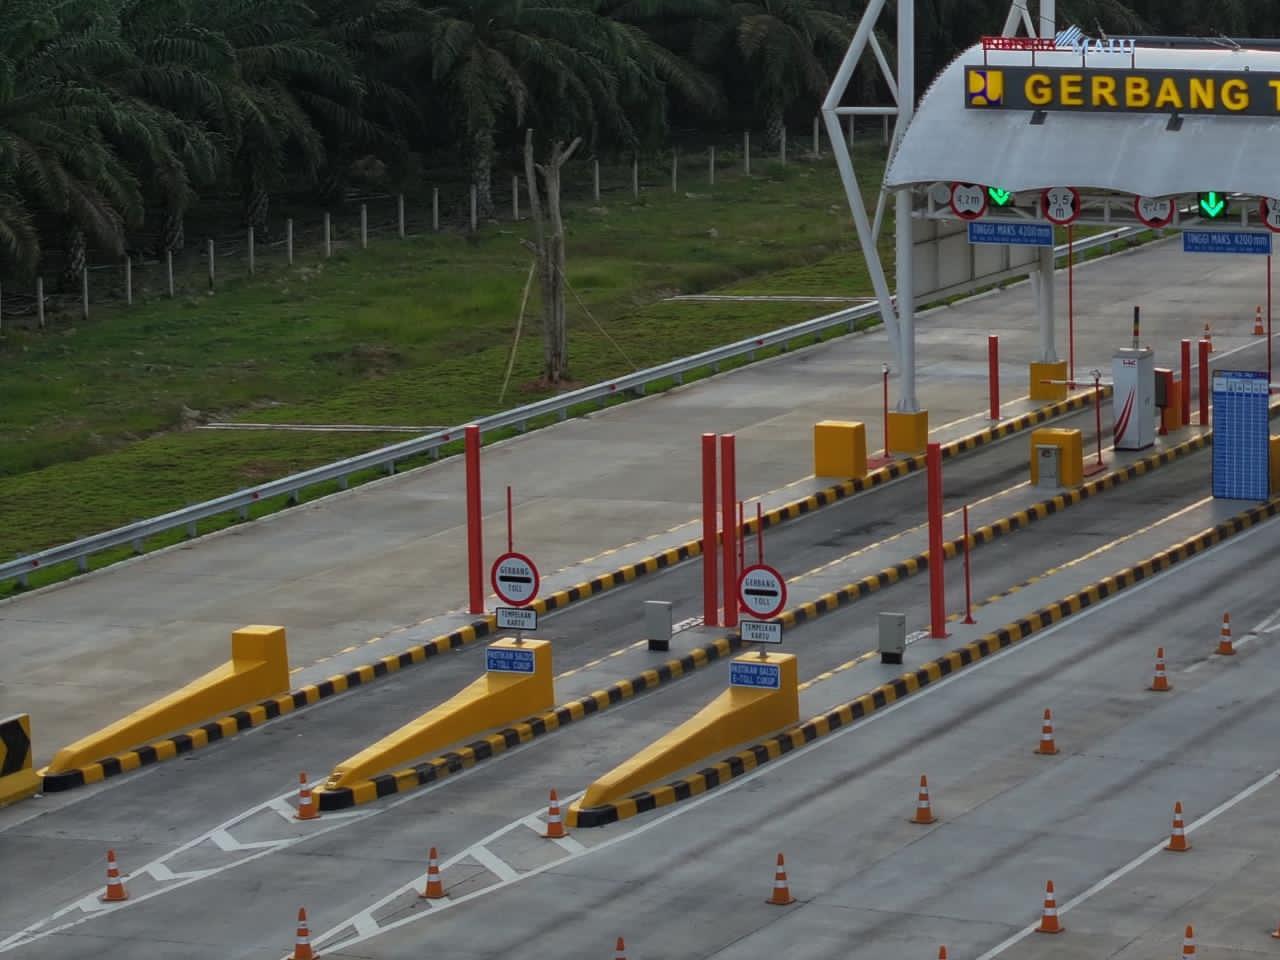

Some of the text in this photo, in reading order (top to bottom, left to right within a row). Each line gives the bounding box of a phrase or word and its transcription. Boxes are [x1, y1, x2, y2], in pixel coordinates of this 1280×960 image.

[1024, 74, 1250, 111] GERBANG
[500, 566, 529, 576] GERBANG
[745, 576, 775, 587] GERBANG
[508, 584, 523, 593] TOLL
[753, 597, 770, 606] TOLL
[744, 623, 777, 632] TEMPELKAN
